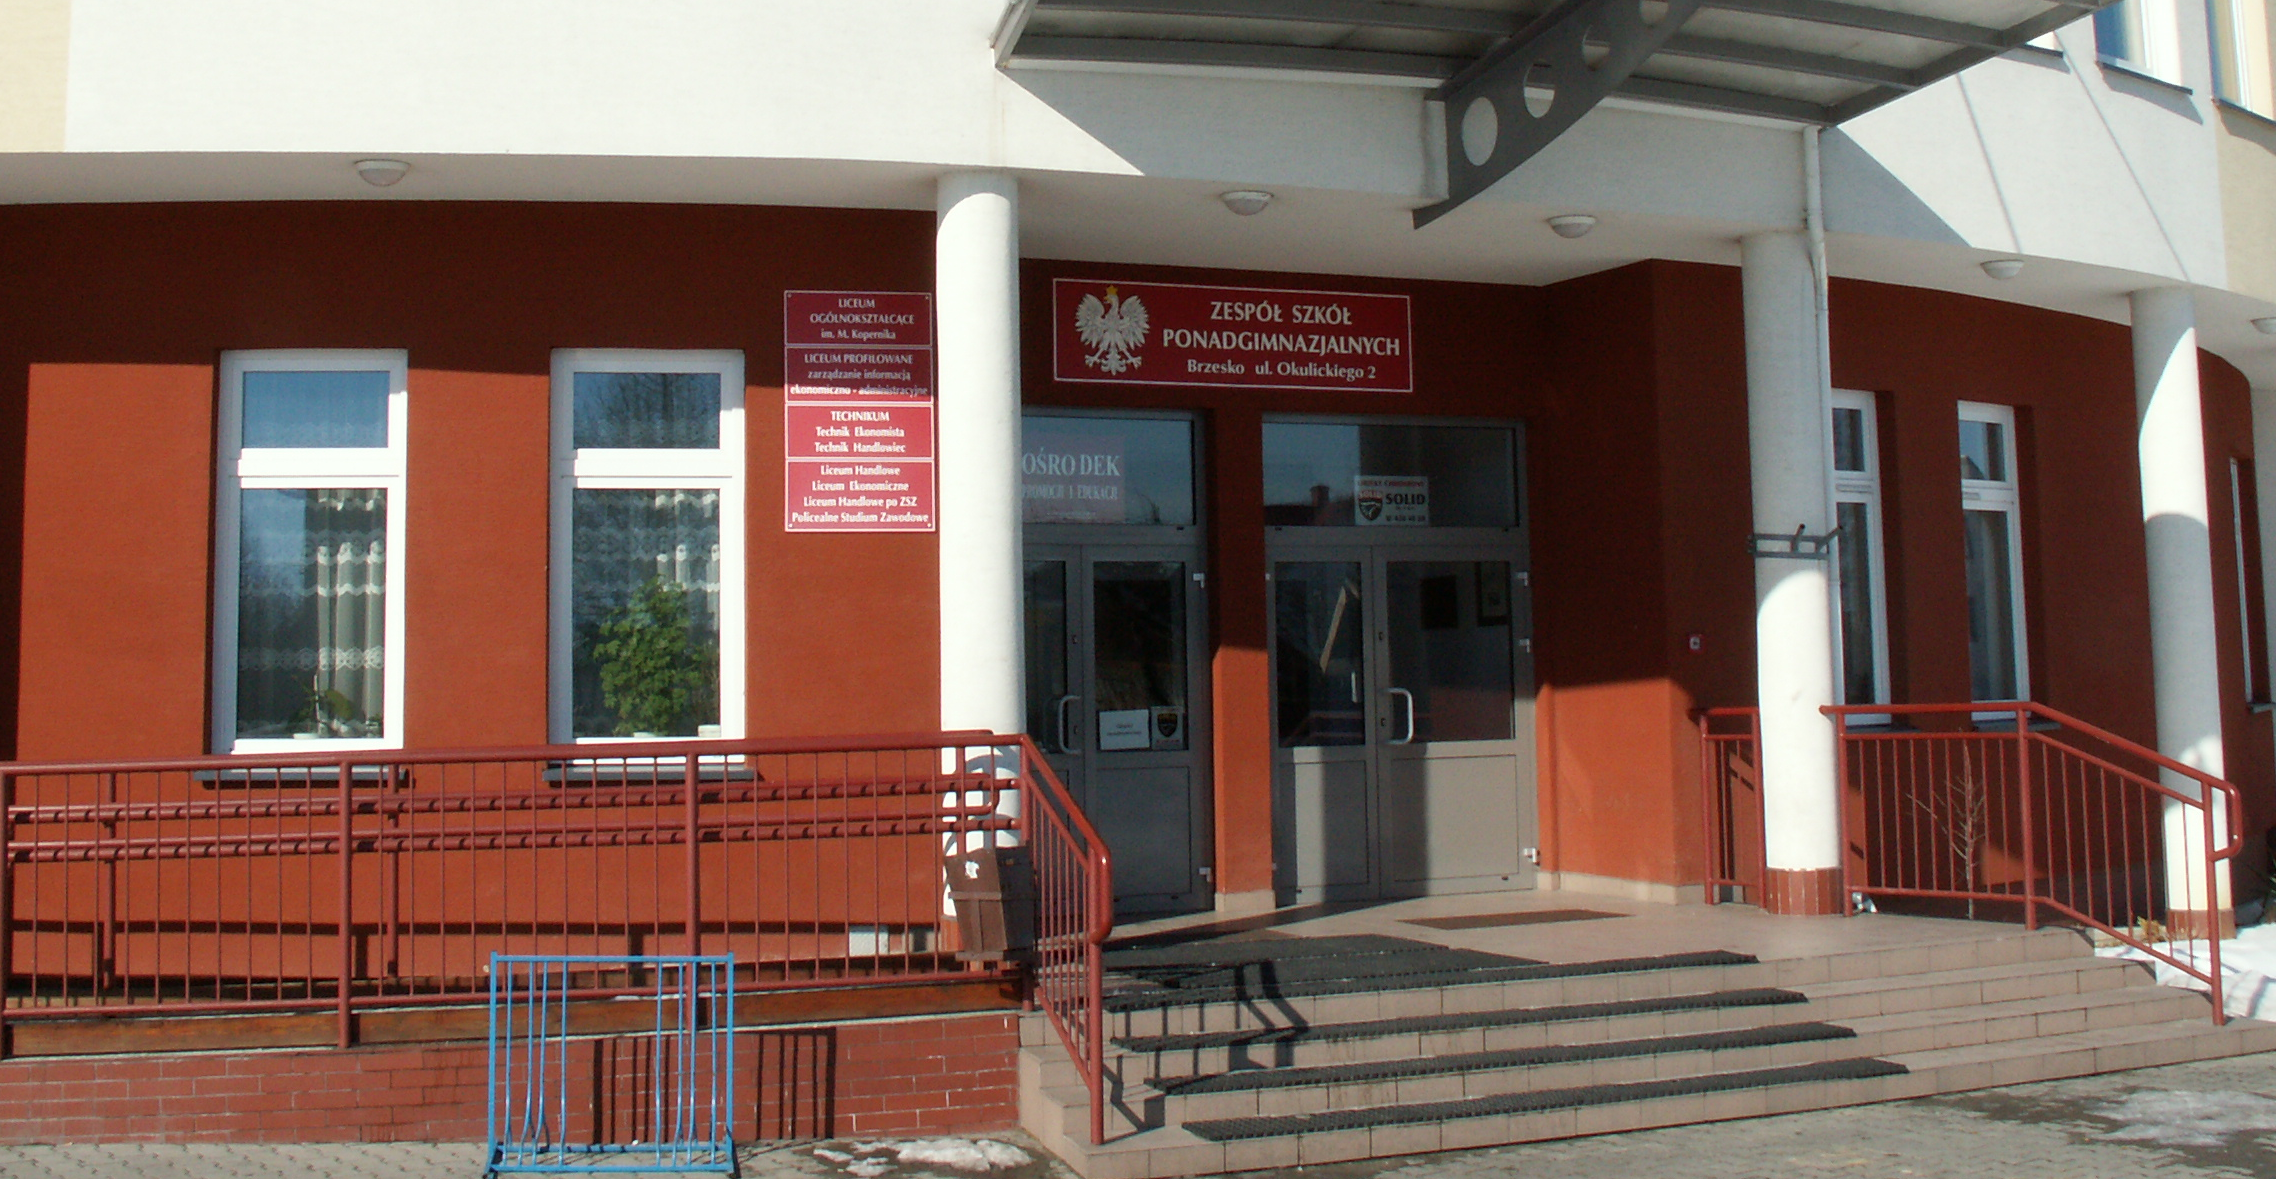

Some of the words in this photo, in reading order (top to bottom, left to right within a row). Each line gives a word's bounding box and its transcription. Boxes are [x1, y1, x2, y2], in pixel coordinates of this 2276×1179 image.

[838, 298, 876, 308] LICEUM
[1210, 299, 1283, 323] ZESPÓŁ
[1292, 302, 1353, 326] SZKÓŁ
[820, 328, 835, 339] im.
[837, 329, 849, 339] M.
[851, 329, 896, 342] Kopernika
[1162, 328, 1401, 357] PONADGIMNAZJALNYCH
[804, 353, 842, 364] LICEUM
[843, 354, 914, 365] PROFILOWANE
[807, 368, 863, 381] zarządzanie
[1187, 358, 1245, 376] Brzesko
[1255, 360, 1274, 377] ul.
[1277, 361, 1365, 383] Okulickiego
[1367, 365, 1376, 379] 2
[790, 384, 852, 395] ekonomiczno
[858, 385, 928, 398] administracyjne
[830, 411, 890, 422] TECHNIKUM
[815, 426, 850, 437] Technik
[854, 427, 905, 437] Ekonomista
[814, 442, 849, 453] Technik
[853, 442, 906, 453] Handlowiec
[820, 465, 853, 475] Liceum
[855, 465, 901, 475] Handlowe
[812, 480, 845, 491] Liceum
[849, 480, 909, 491] Ekonomiczne
[803, 496, 836, 507] Liceum
[838, 496, 884, 507] Handlowe
[885, 499, 898, 509] po
[899, 497, 918, 507] ZSZ
[1385, 493, 1426, 505] SOLID
[792, 512, 839, 523] Policealne
[840, 512, 878, 523] Studium
[880, 512, 929, 523] Zawodowe
